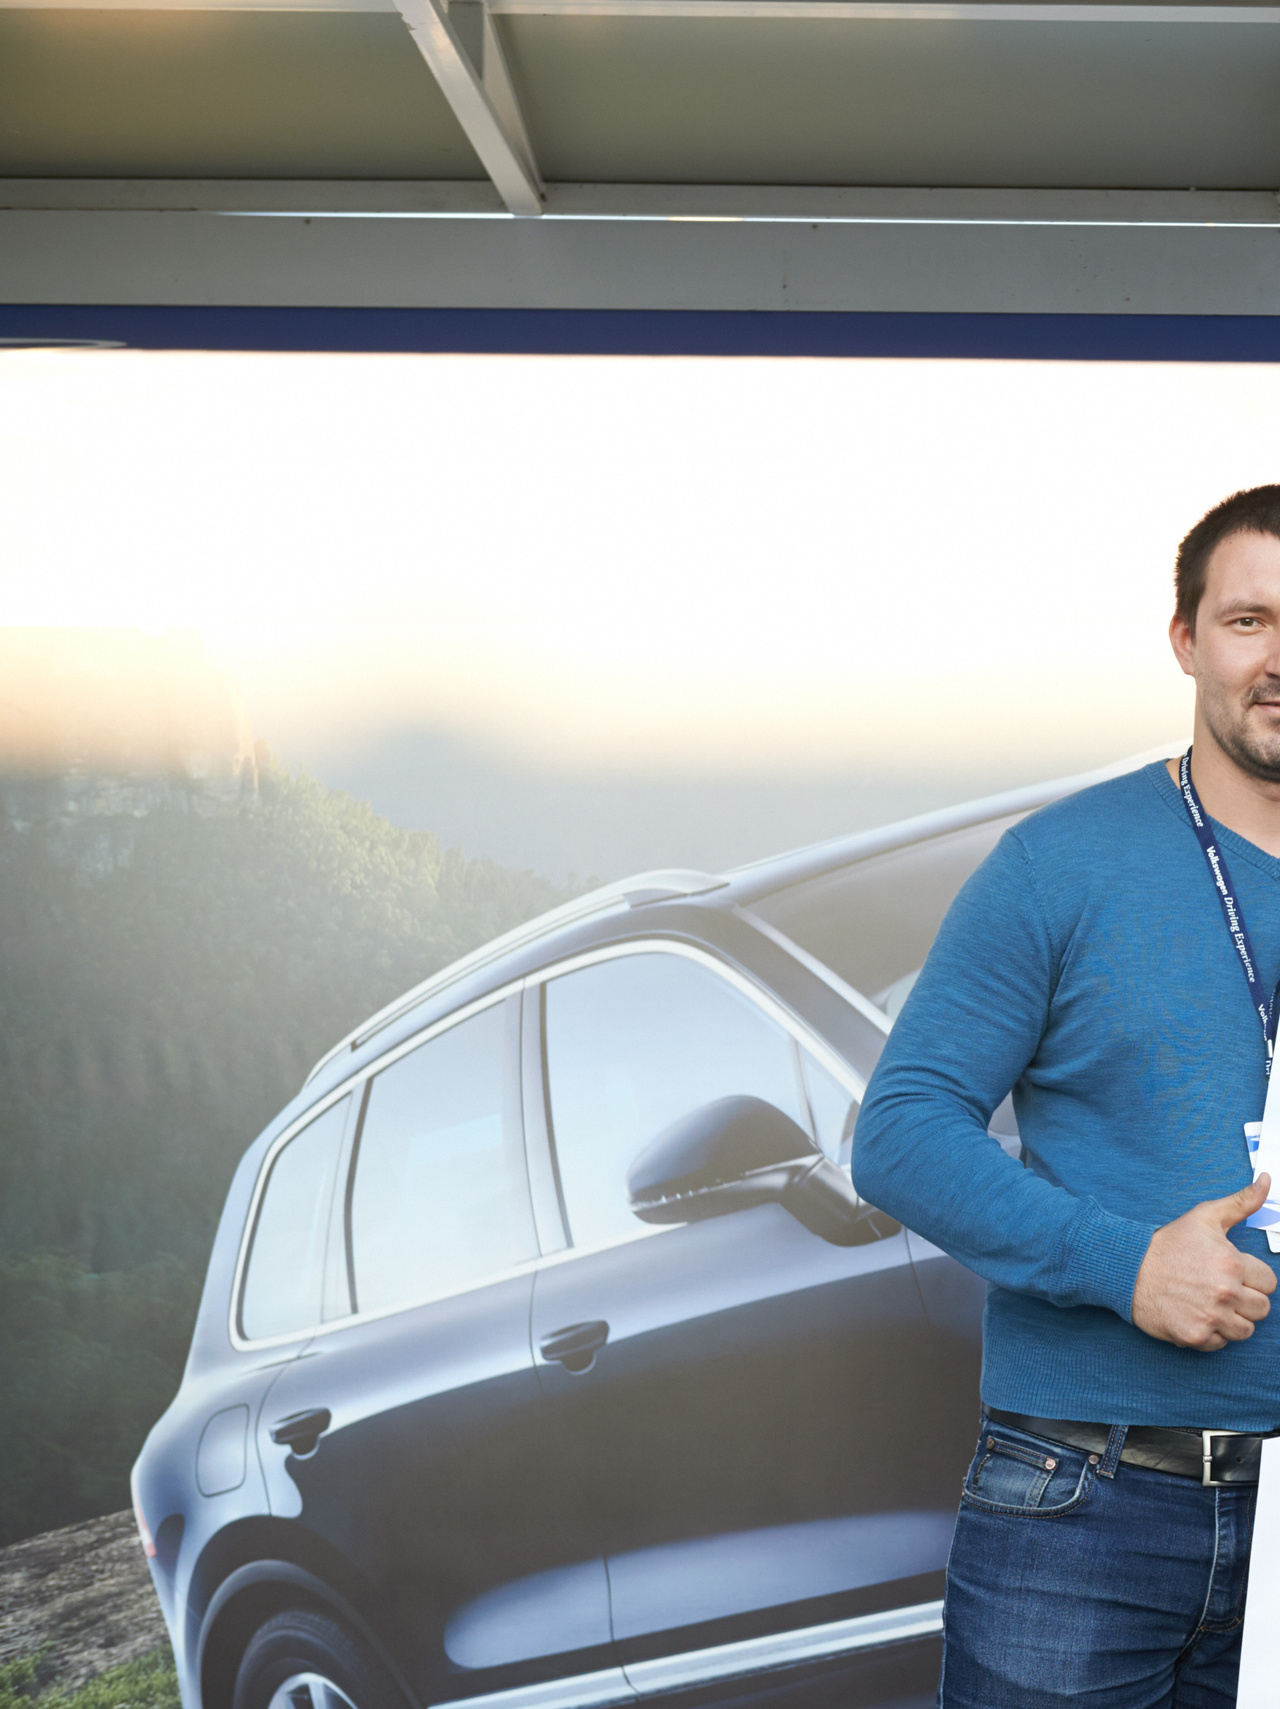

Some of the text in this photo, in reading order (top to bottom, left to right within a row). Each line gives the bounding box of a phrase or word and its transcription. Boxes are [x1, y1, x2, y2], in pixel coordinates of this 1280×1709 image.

[1183, 784, 1204, 828] Experience
[1206, 845, 1256, 984] Volkswagen Driving Experience
